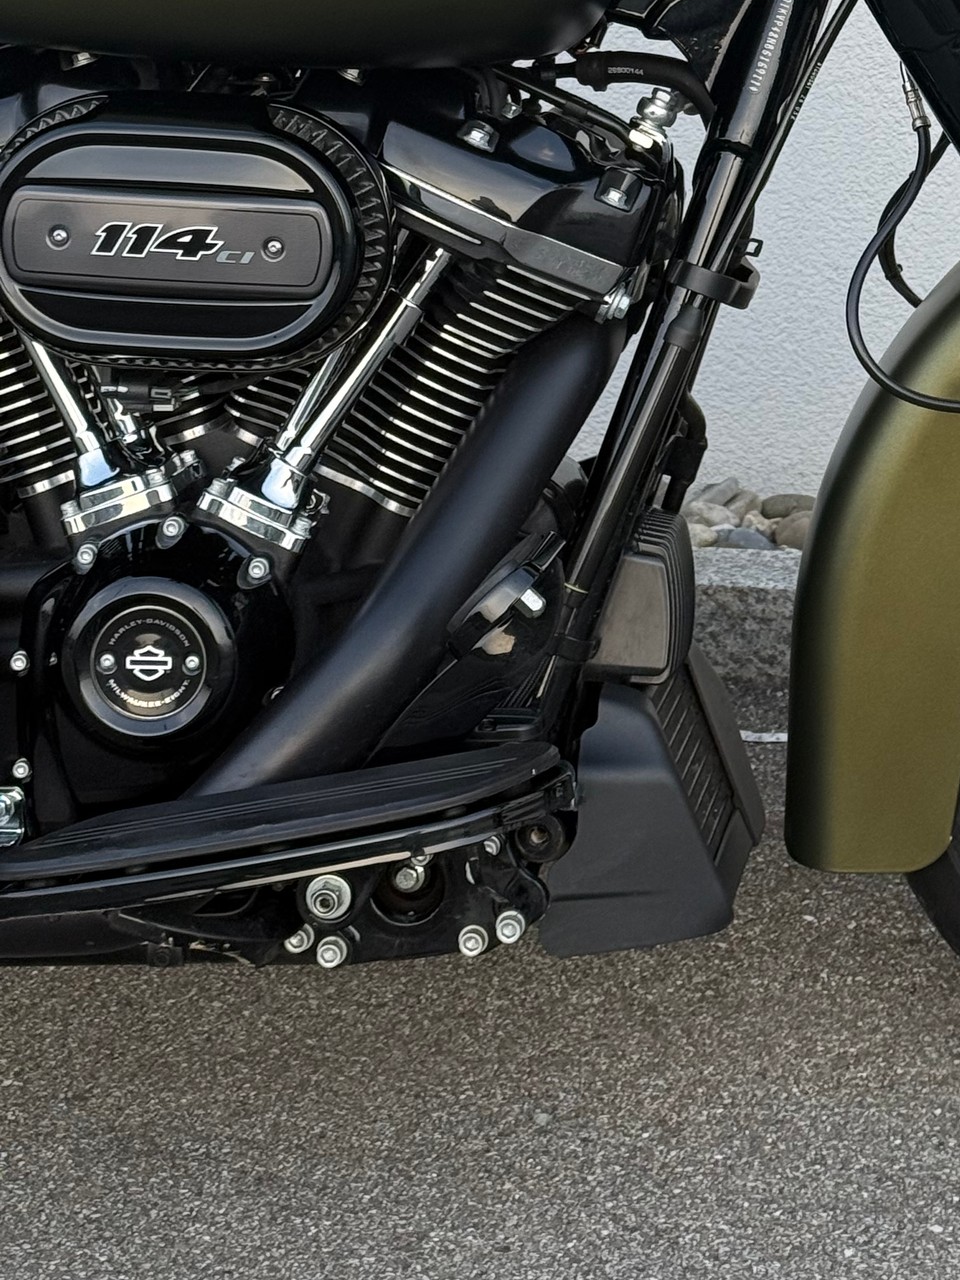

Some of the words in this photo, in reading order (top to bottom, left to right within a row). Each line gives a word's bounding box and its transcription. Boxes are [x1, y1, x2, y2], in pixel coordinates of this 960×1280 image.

[90, 221, 225, 261] 114
[216, 250, 255, 264] CI
[108, 618, 190, 648] HARLEY-DAVIDSON
[108, 678, 190, 708] MILWAUKEE-EIGHT
